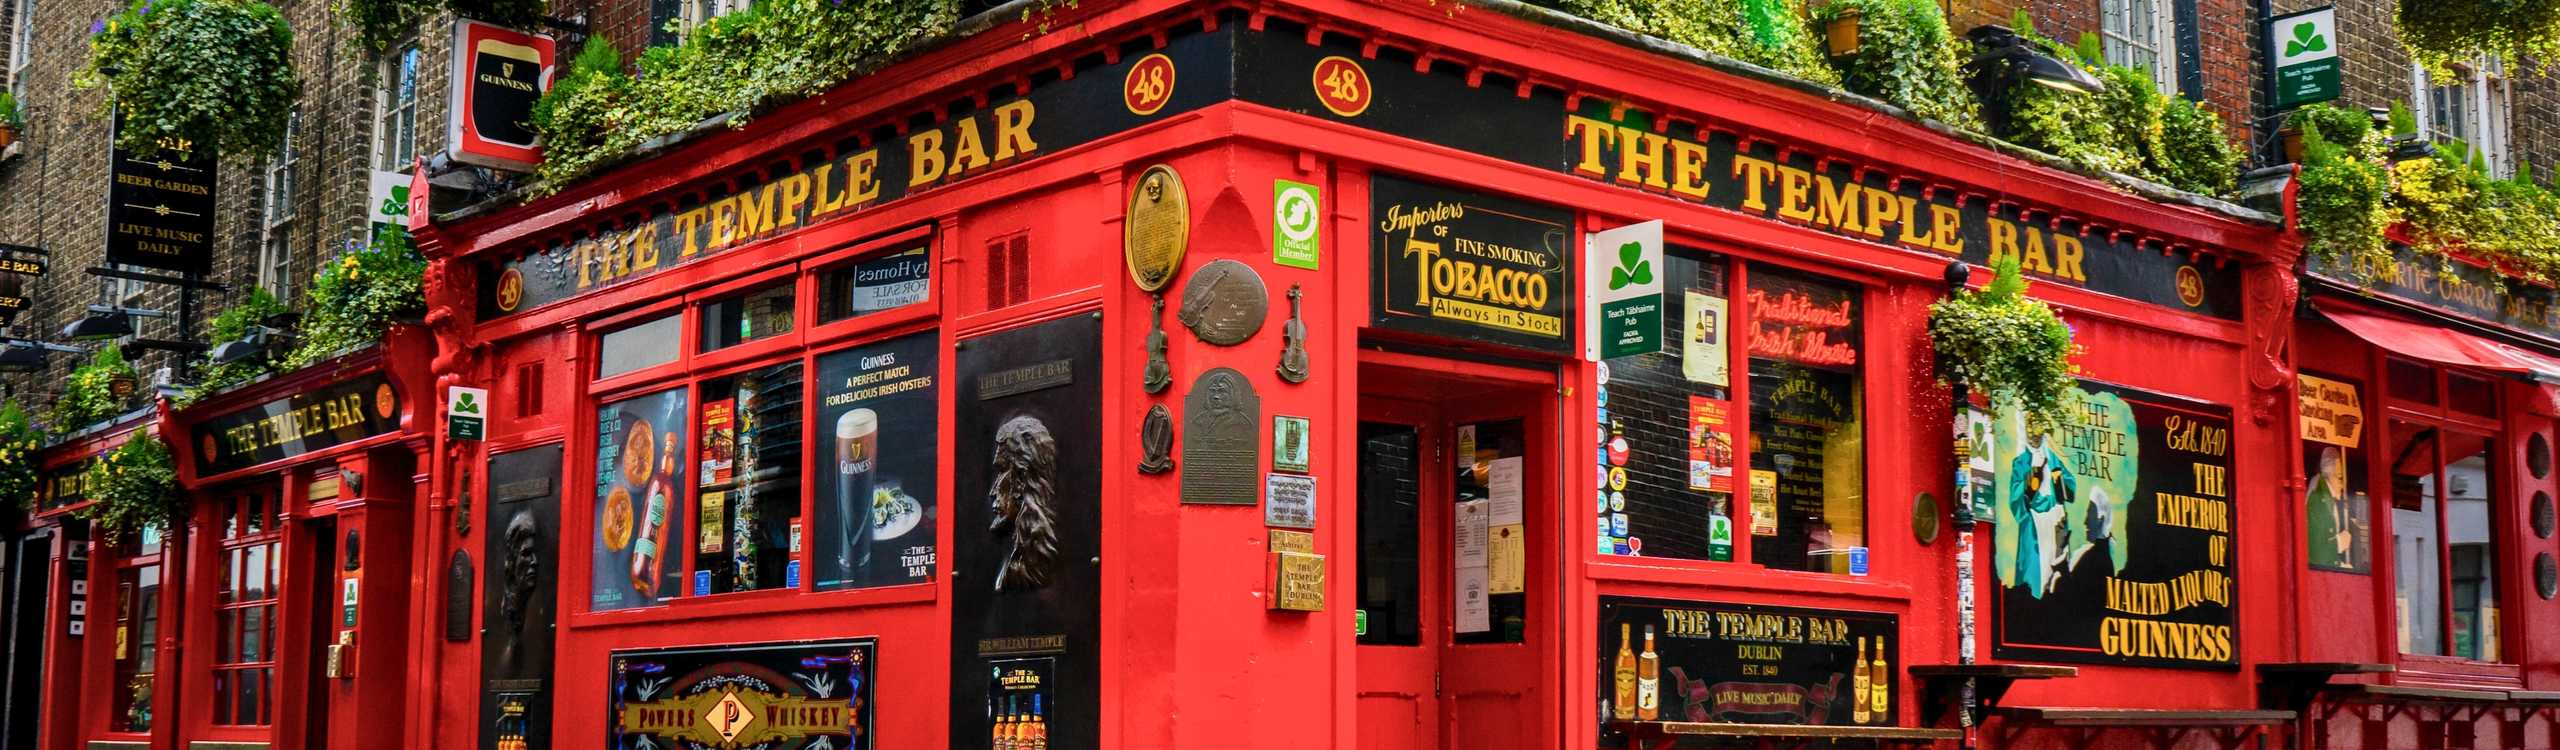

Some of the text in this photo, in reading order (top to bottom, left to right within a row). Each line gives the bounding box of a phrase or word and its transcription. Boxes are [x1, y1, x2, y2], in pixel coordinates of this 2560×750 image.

[481, 73, 533, 92] GUINNESS
[1133, 66, 1164, 104] 48
[1324, 64, 1358, 103] 48
[118, 173, 209, 195] BEER GARDEN
[571, 98, 1038, 289] THE TEMPLE BAR
[1567, 114, 2086, 283] THE TEMPLE BAR
[1381, 201, 1464, 238] Importers
[1433, 225, 1448, 237] OF
[118, 222, 203, 243] LIVE MUSIC
[1284, 239, 1311, 251] Official
[137, 240, 183, 255] DAILY
[1281, 248, 1312, 260] Member
[1455, 238, 1546, 267] FINE SMOKING
[13, 262, 40, 274] BAR
[1404, 238, 1548, 310] TOBACCO
[501, 278, 517, 304] 48
[2179, 273, 2198, 298] 48
[1434, 299, 1558, 333] Always in Stock
[1747, 289, 1850, 328] Traditional
[1625, 317, 1637, 326] Pub
[1747, 320, 1855, 364] Irish Music
[861, 353, 895, 370] GUINNESS
[1000, 365, 1044, 385] TEMPLE
[1047, 360, 1071, 377] BAR
[846, 365, 910, 388] A PERFECT MATCH
[826, 376, 932, 406] FOR DELICIOUS IRISH OYSTERS
[1770, 380, 1817, 405] TEMPLE
[2320, 384, 2349, 406] Garden
[226, 393, 365, 456] THE TEMPLE BAR
[2080, 401, 2111, 428] THE
[2300, 399, 2333, 425] Smoking
[2060, 423, 2127, 456] TEMPLE
[2200, 425, 2227, 456] 1840
[2307, 421, 2327, 440] Area
[840, 458, 872, 475] GUINNESS
[2077, 451, 2112, 481] BAR
[59, 475, 78, 497] THE
[2192, 462, 2226, 498] THE
[2155, 491, 2228, 533] EMPEROR
[900, 553, 936, 567] TEMPLE
[911, 546, 926, 555] THE
[2208, 534, 2228, 568] OF
[909, 566, 928, 577] BAR
[1297, 563, 1312, 572] THE
[1289, 591, 1318, 601] DUBLIN
[2105, 569, 2232, 616] MALTED LIQUORS
[1663, 609, 1850, 646] THE TEMPLE BAR
[2100, 616, 2232, 663] GUINNESS
[1030, 634, 1065, 649] TEMPLE
[1738, 645, 1782, 660] DUBLIN
[1000, 675, 1040, 686] TEMPLE BAR
[1742, 664, 1778, 676] EST. 1840
[1716, 691, 1802, 705] LIVE MUSIC DAILY
[639, 700, 841, 733] POWERS P WHISKEY
